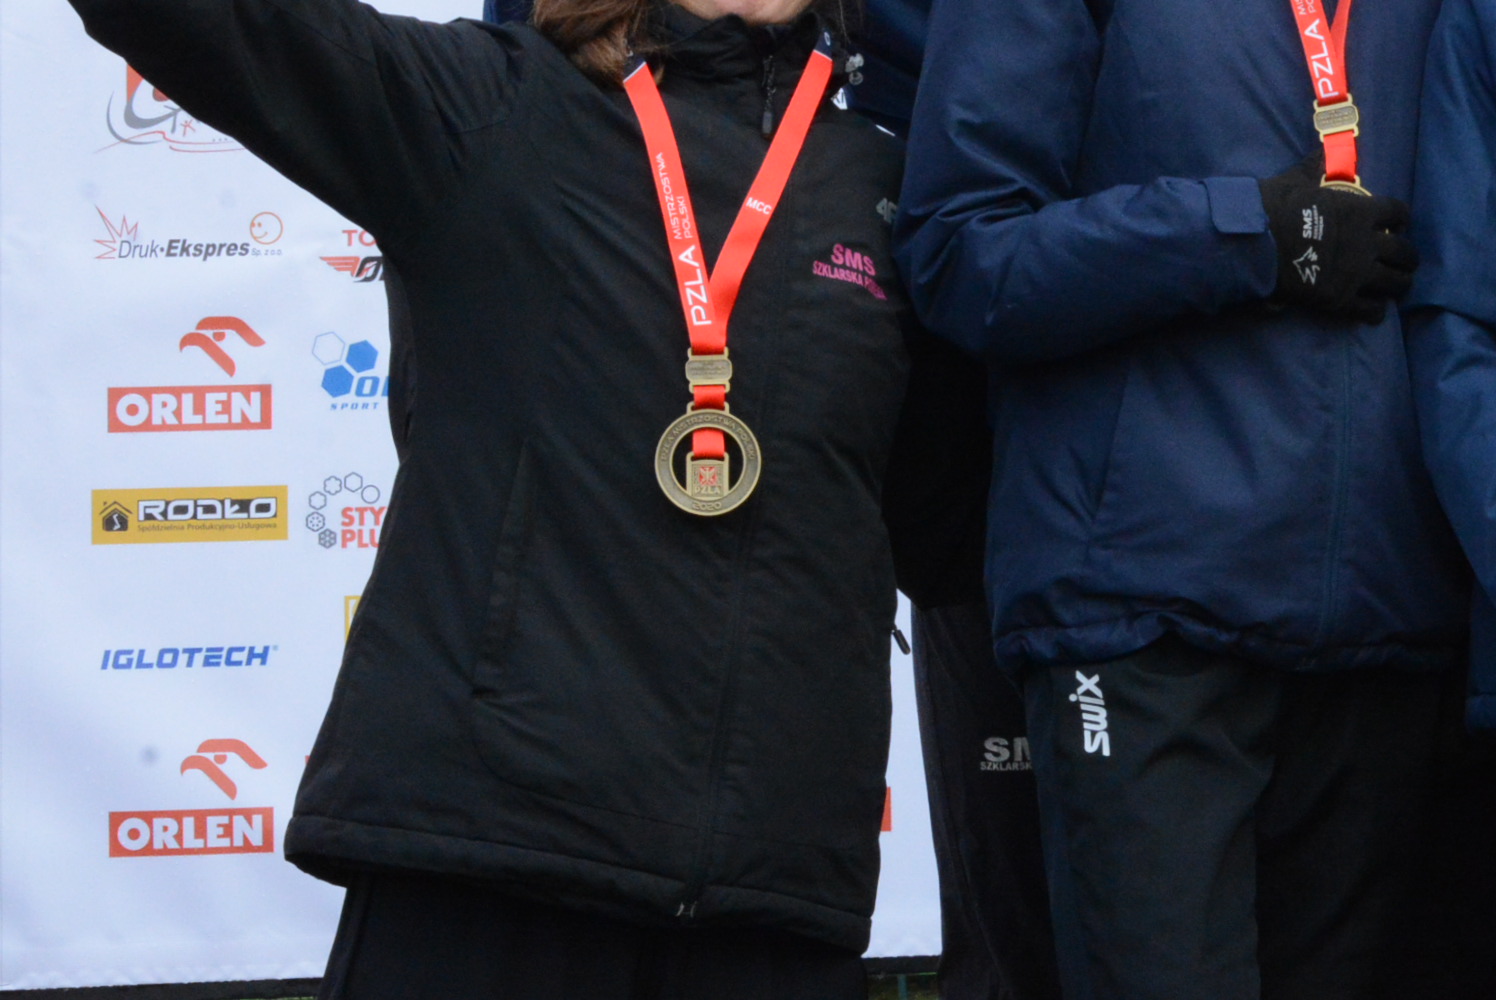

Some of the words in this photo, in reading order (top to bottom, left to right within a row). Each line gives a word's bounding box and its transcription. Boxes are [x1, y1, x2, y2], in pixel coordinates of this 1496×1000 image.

[1304, 18, 1339, 100] PZLA
[655, 152, 683, 240] MISTRZOSTWA
[745, 196, 773, 216] MCC
[676, 195, 693, 239] POLSKI
[1302, 208, 1313, 239] SMS
[812, 260, 864, 288] SZKLARSKA
[831, 243, 876, 277] SMS
[678, 244, 713, 327] PZLA
[116, 391, 262, 426] ORLEN
[330, 402, 379, 411] SPORT
[138, 497, 277, 522] RODŁO
[692, 501, 723, 511] 2020
[1068, 669, 1111, 757] swix
[980, 761, 1033, 772] SZKLARSK
[117, 814, 263, 851] ORLEN
